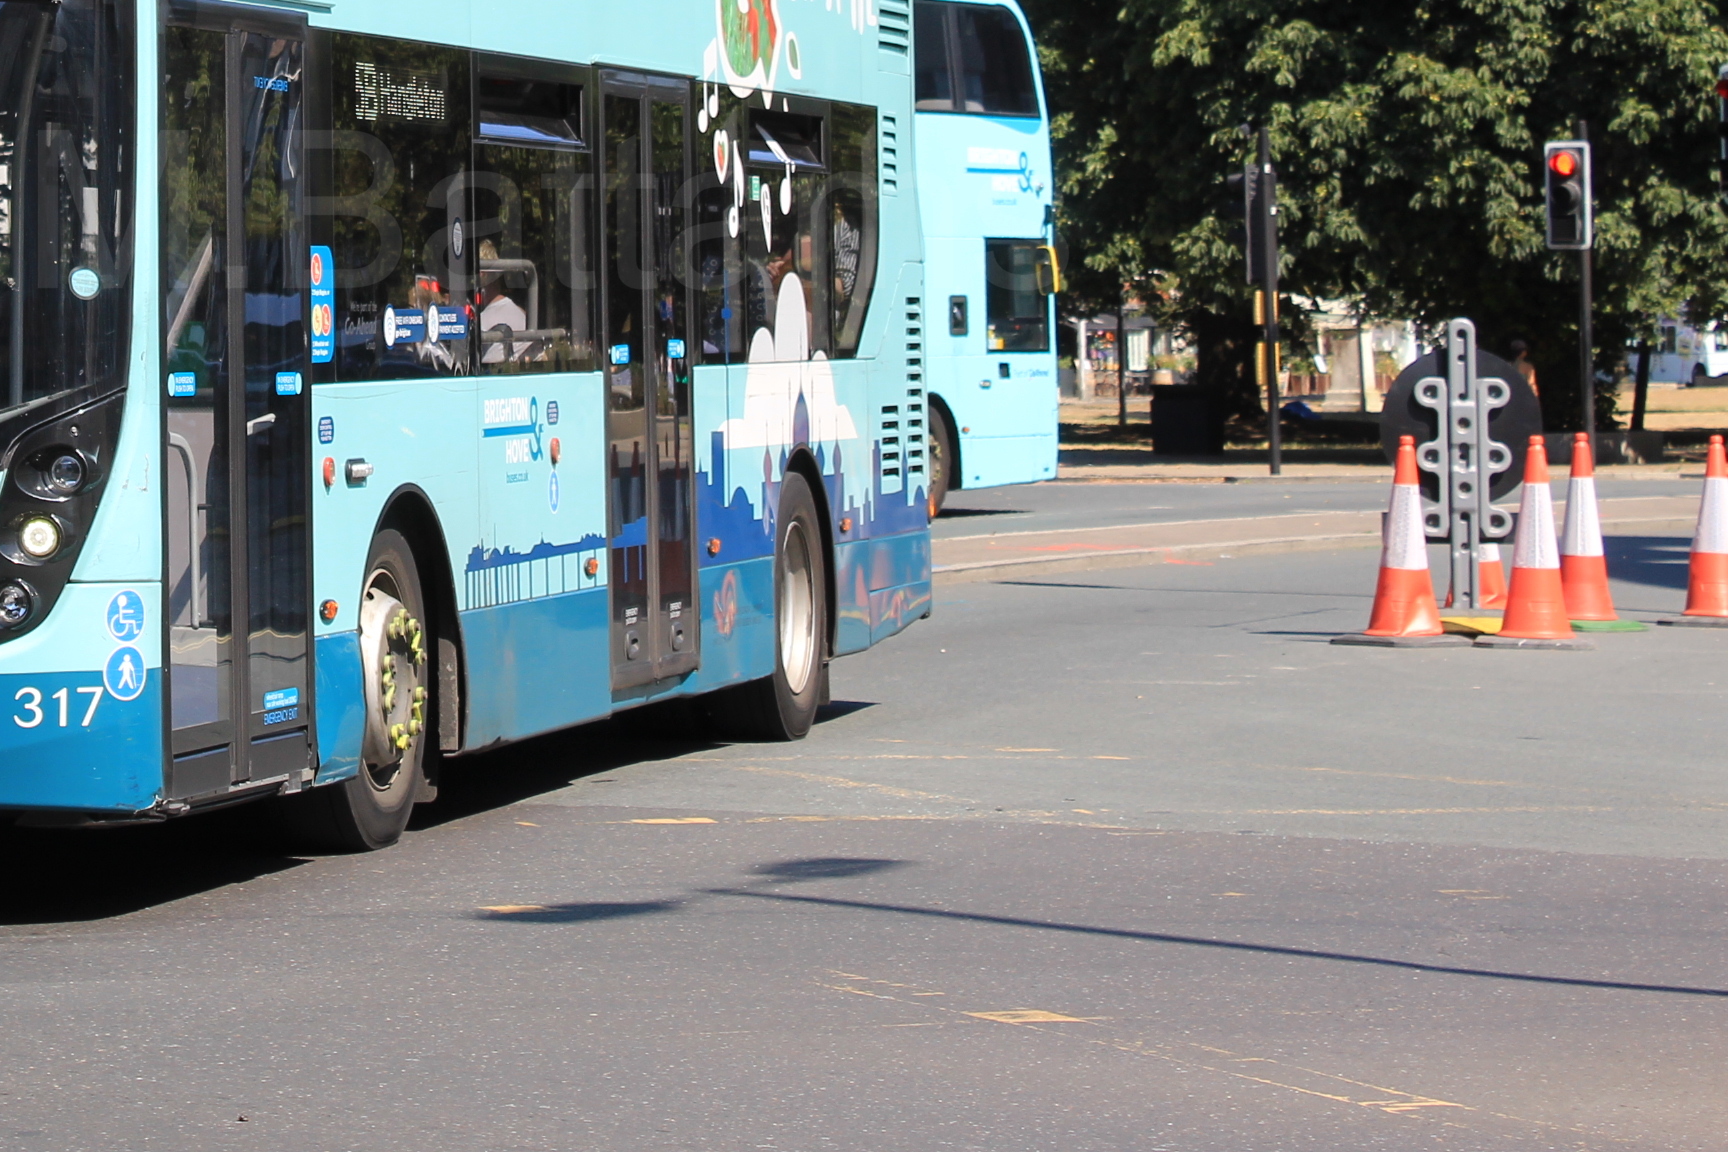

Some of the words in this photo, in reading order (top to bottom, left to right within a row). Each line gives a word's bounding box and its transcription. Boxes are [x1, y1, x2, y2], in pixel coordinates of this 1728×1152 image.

[355, 61, 378, 121] 5B
[380, 72, 445, 121] Hangleton
[484, 397, 529, 424] BRIGHTON
[505, 438, 529, 464] HOVE
[13, 686, 105, 729] 317
